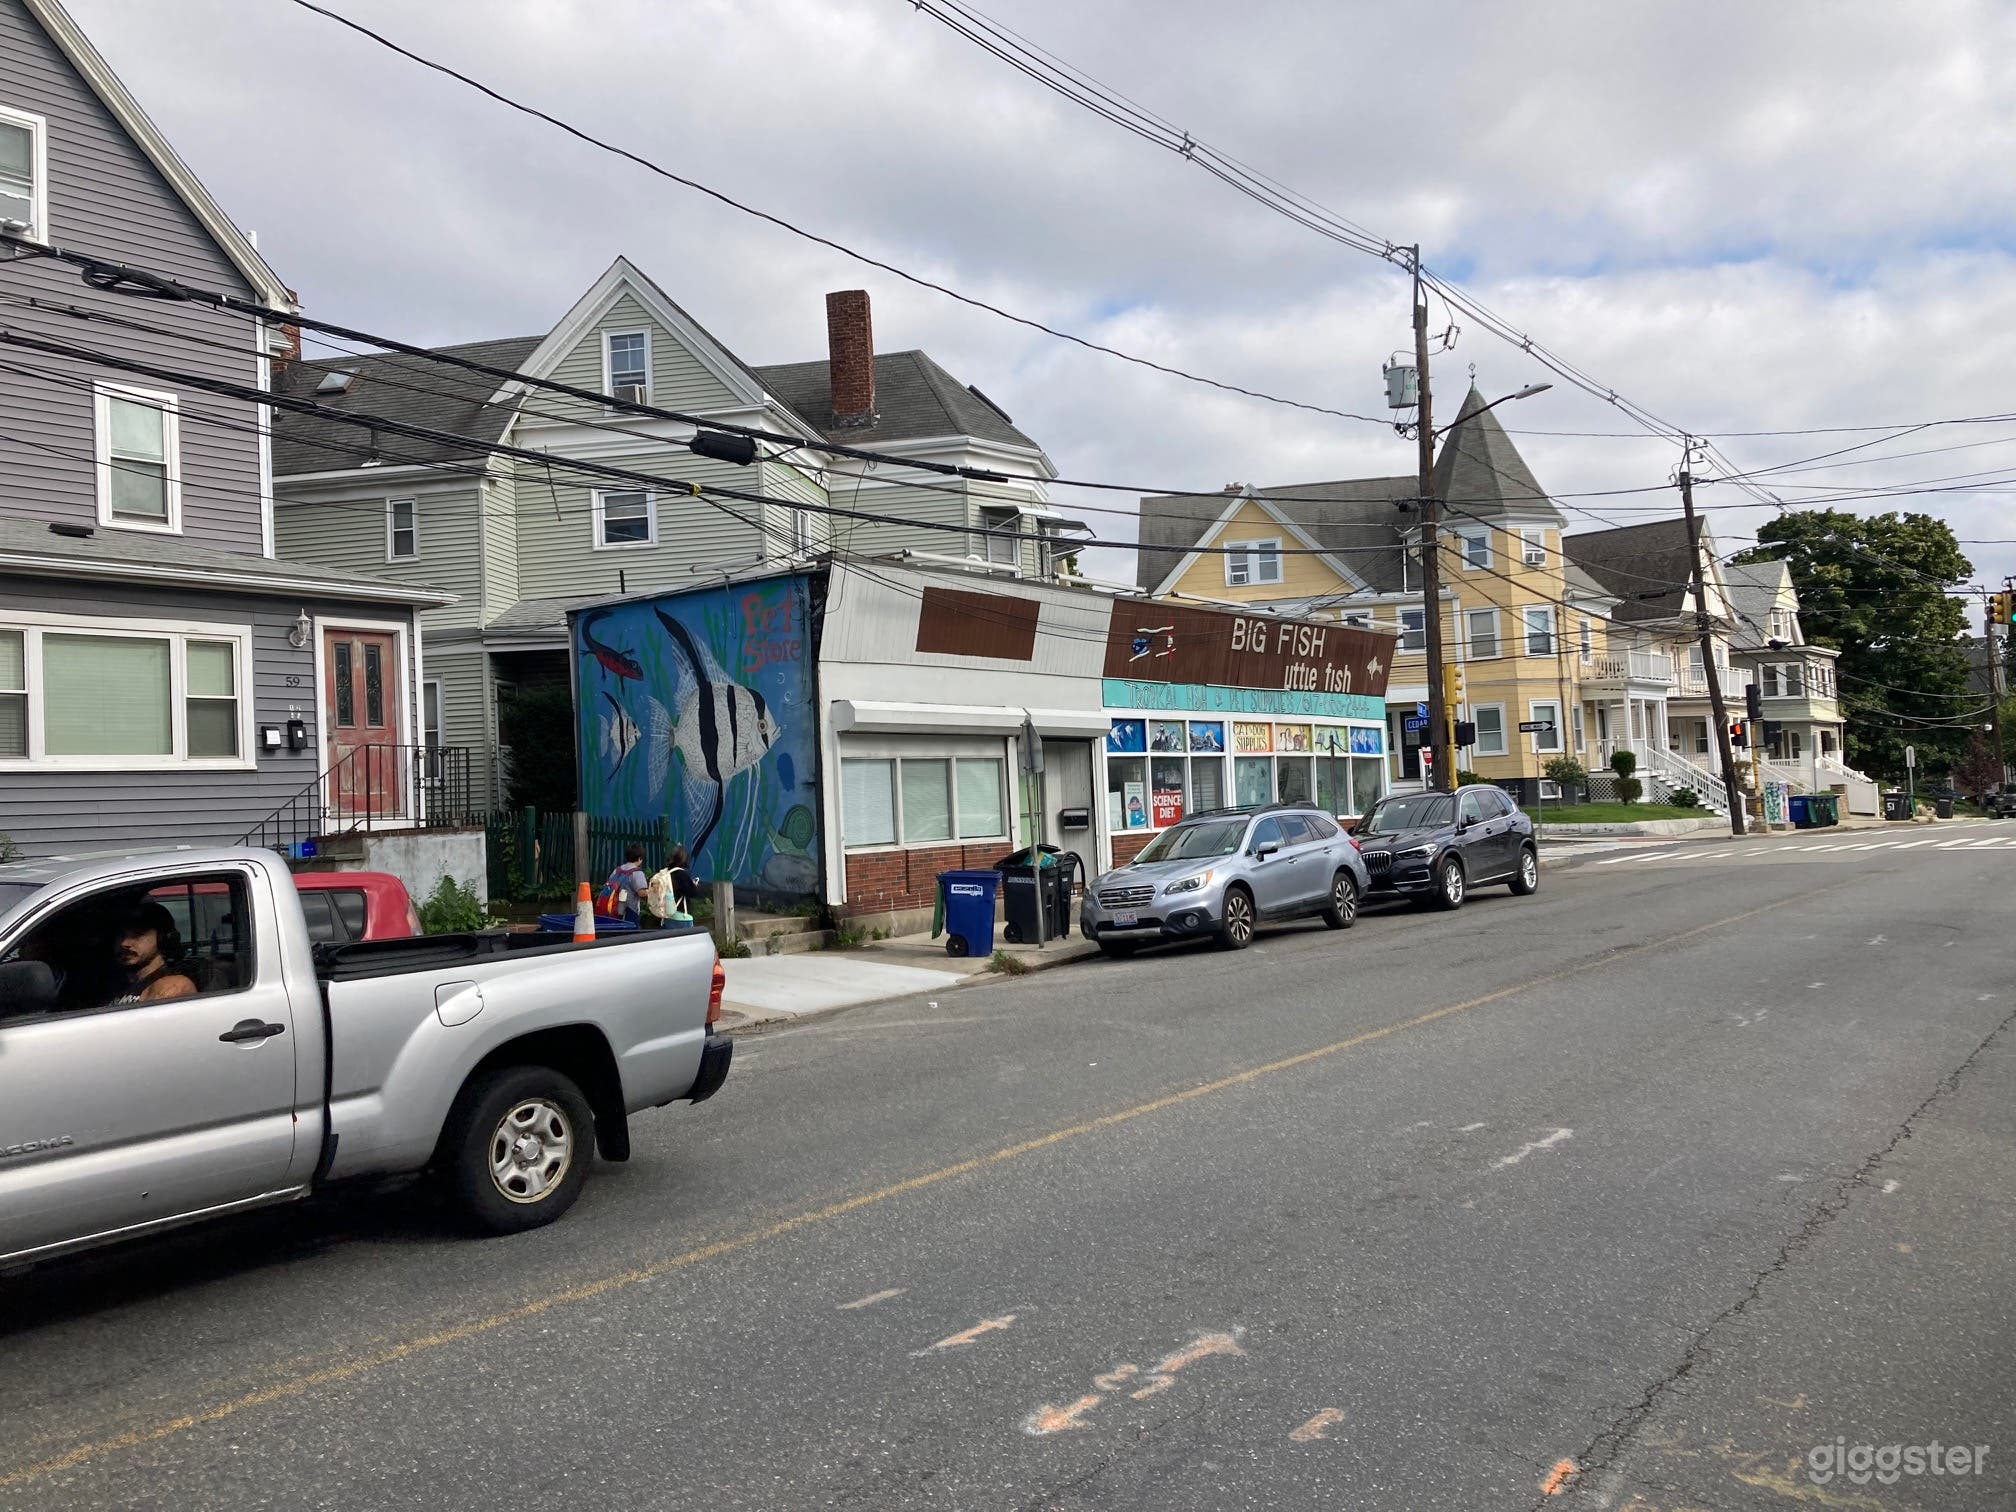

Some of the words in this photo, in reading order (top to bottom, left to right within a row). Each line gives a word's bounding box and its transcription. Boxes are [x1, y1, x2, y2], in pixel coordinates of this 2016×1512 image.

[1231, 618, 1267, 653] BIG
[1277, 624, 1326, 658] FISH
[286, 676, 300, 687] 59
[1233, 724, 1248, 735] CAT
[1153, 795, 1183, 807] SCIENCE
